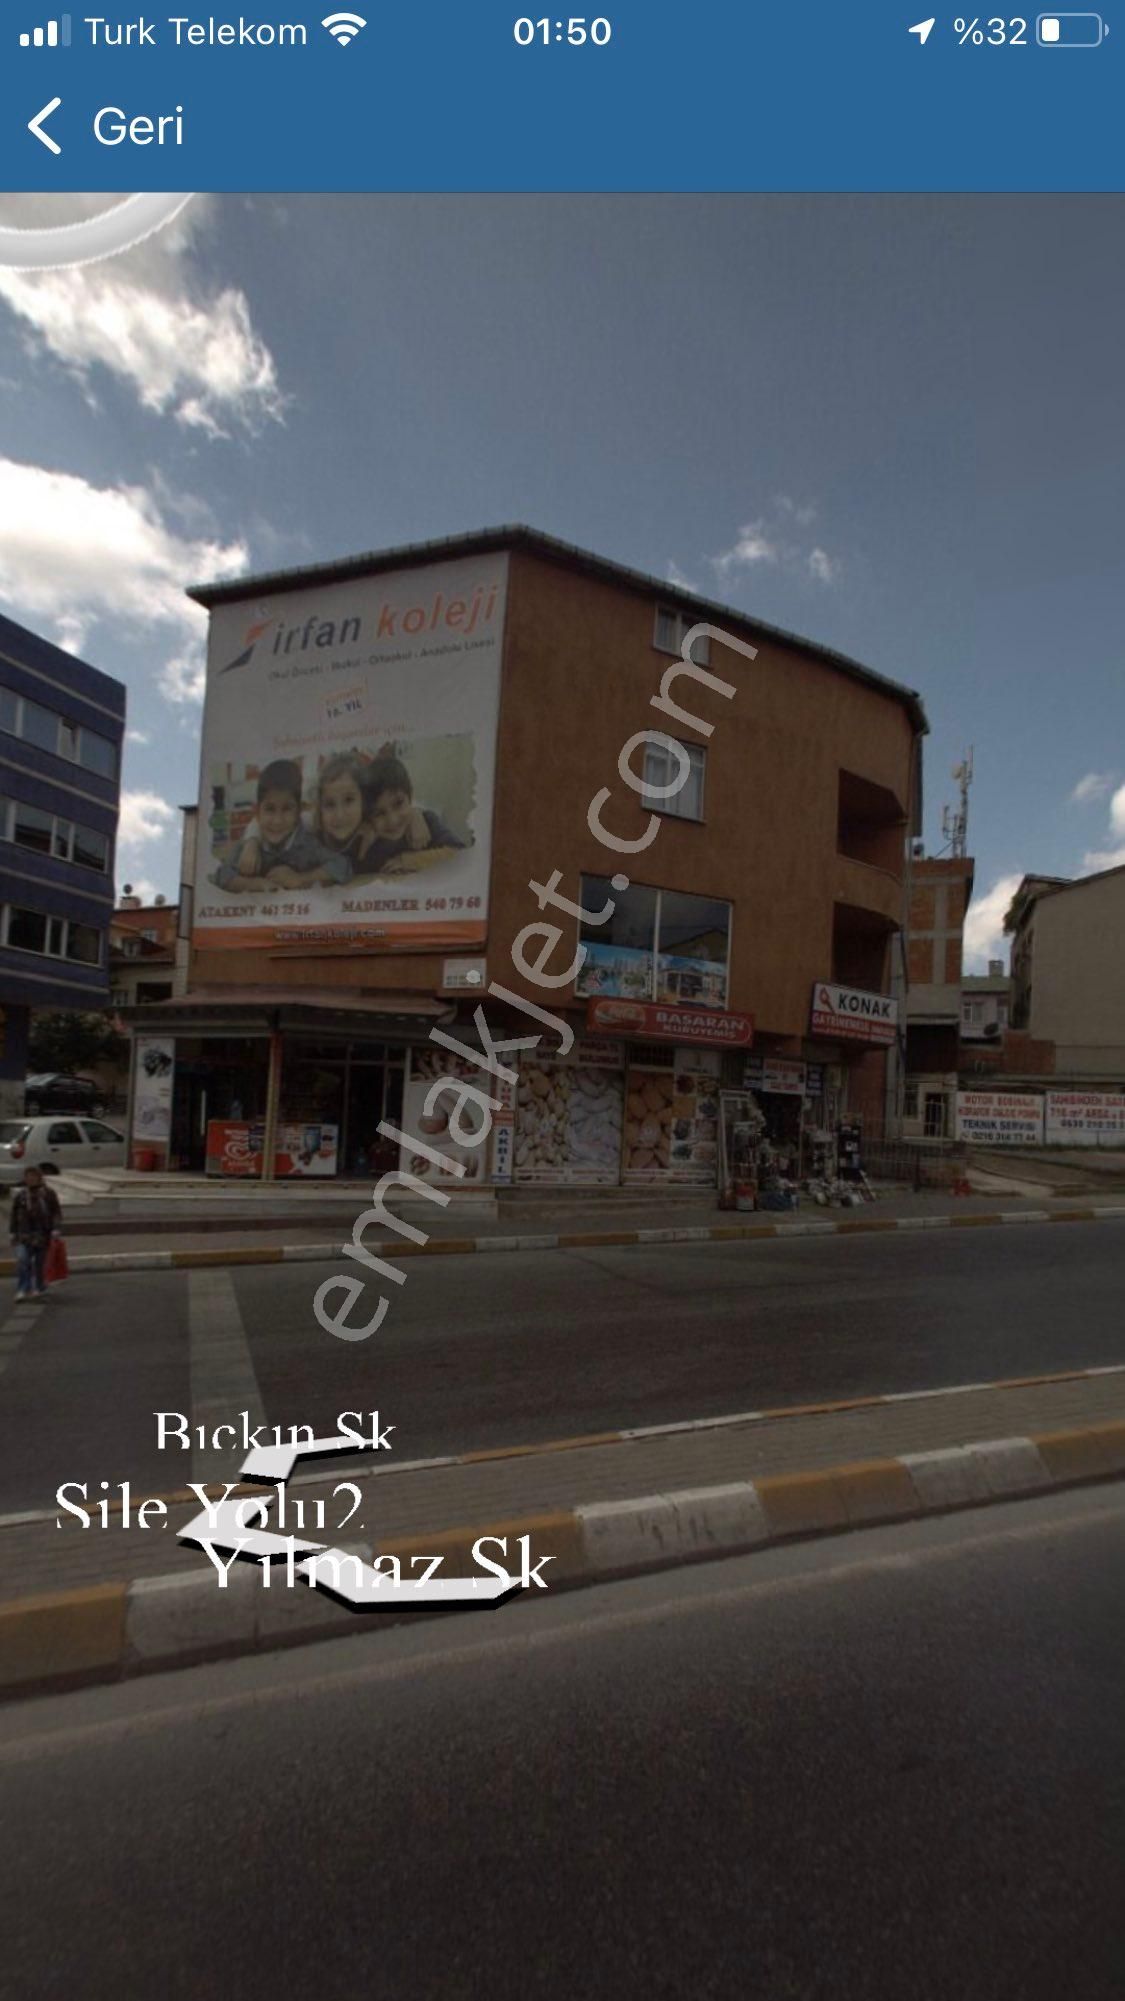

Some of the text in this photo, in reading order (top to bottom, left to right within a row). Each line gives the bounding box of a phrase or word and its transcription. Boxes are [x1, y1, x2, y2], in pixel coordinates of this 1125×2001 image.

[272, 586, 498, 655] irfan koleji
[199, 905, 256, 919] ATAKENT
[342, 900, 419, 913] MADENLER
[838, 993, 891, 1019] KONAK
